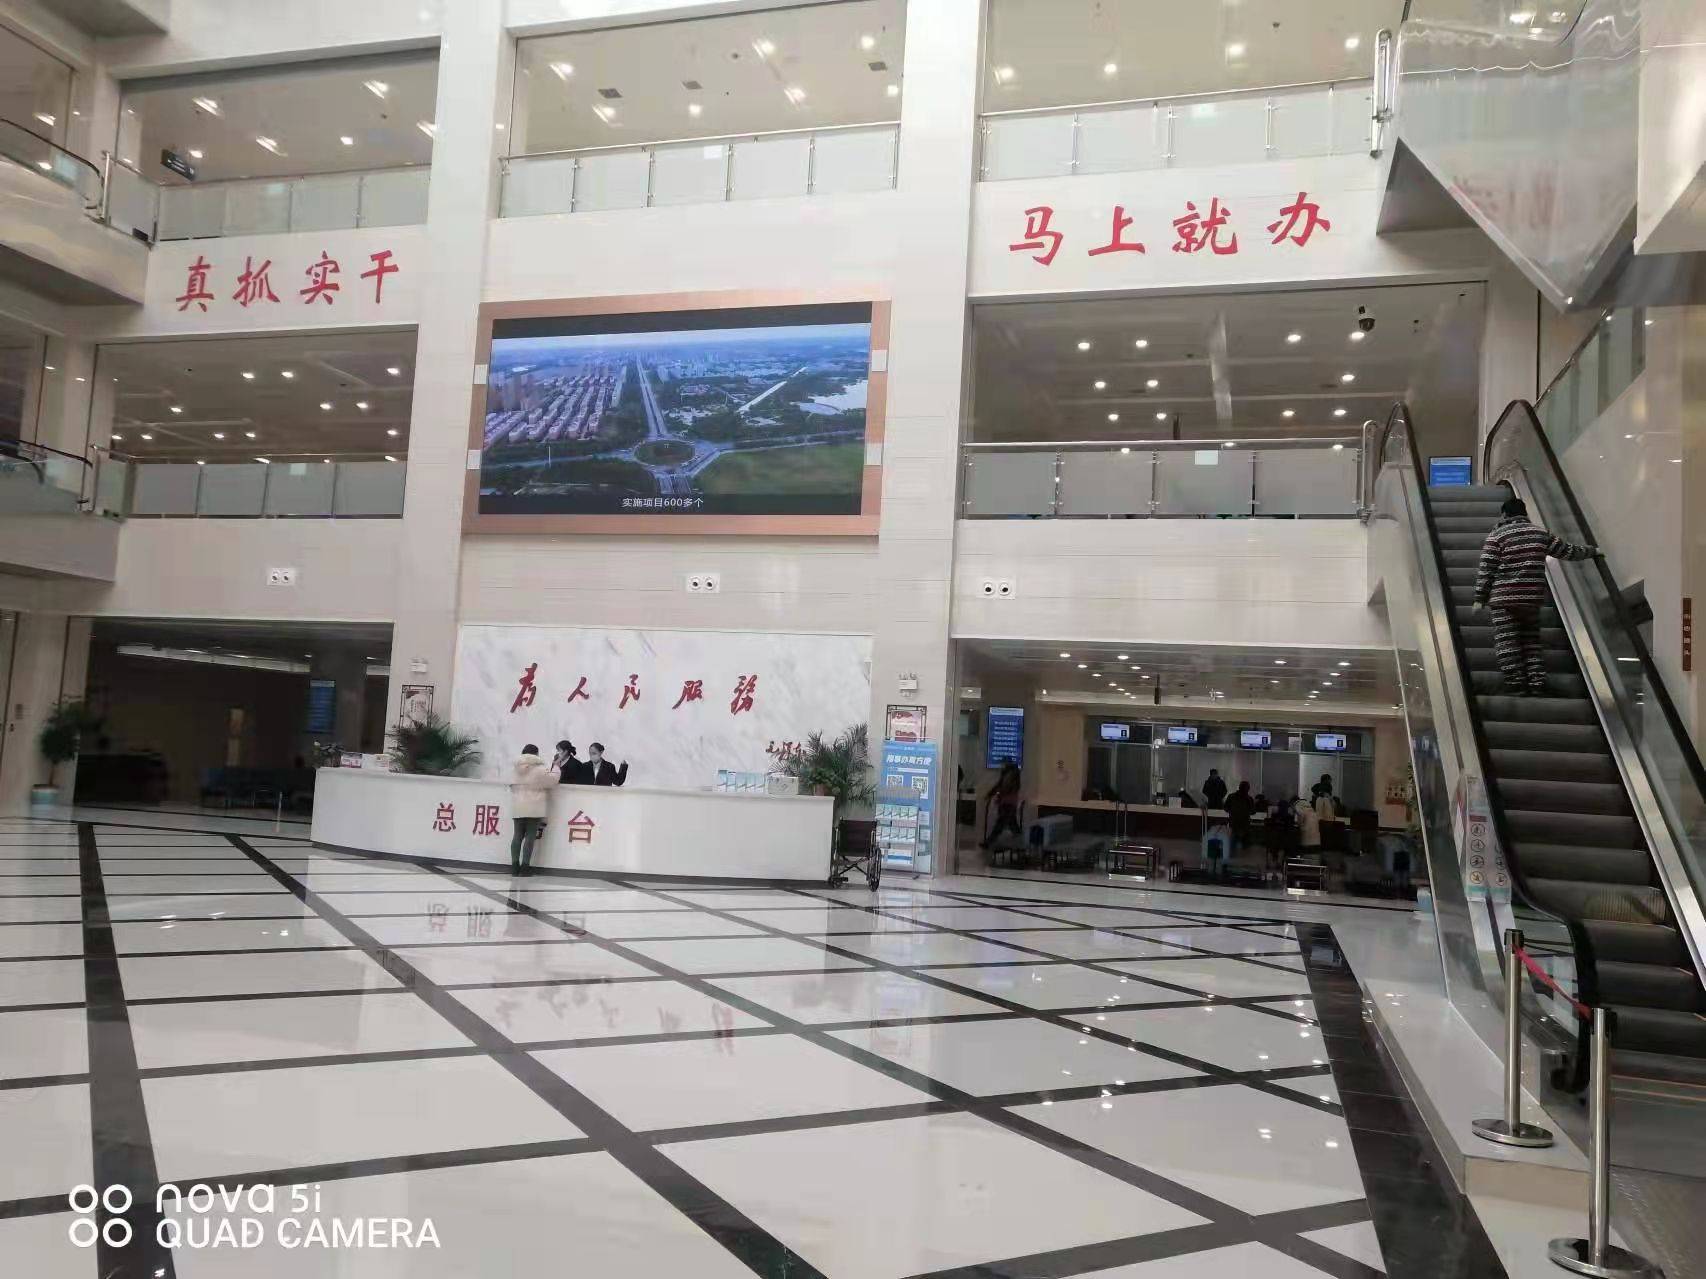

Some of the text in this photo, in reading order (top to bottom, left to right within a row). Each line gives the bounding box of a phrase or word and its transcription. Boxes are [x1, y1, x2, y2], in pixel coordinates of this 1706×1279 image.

[1009, 191, 1331, 266] 马上就办
[175, 249, 399, 312] 真抓实干
[621, 497, 704, 508] 实施项目600多个
[432, 802, 595, 844] 总服台
